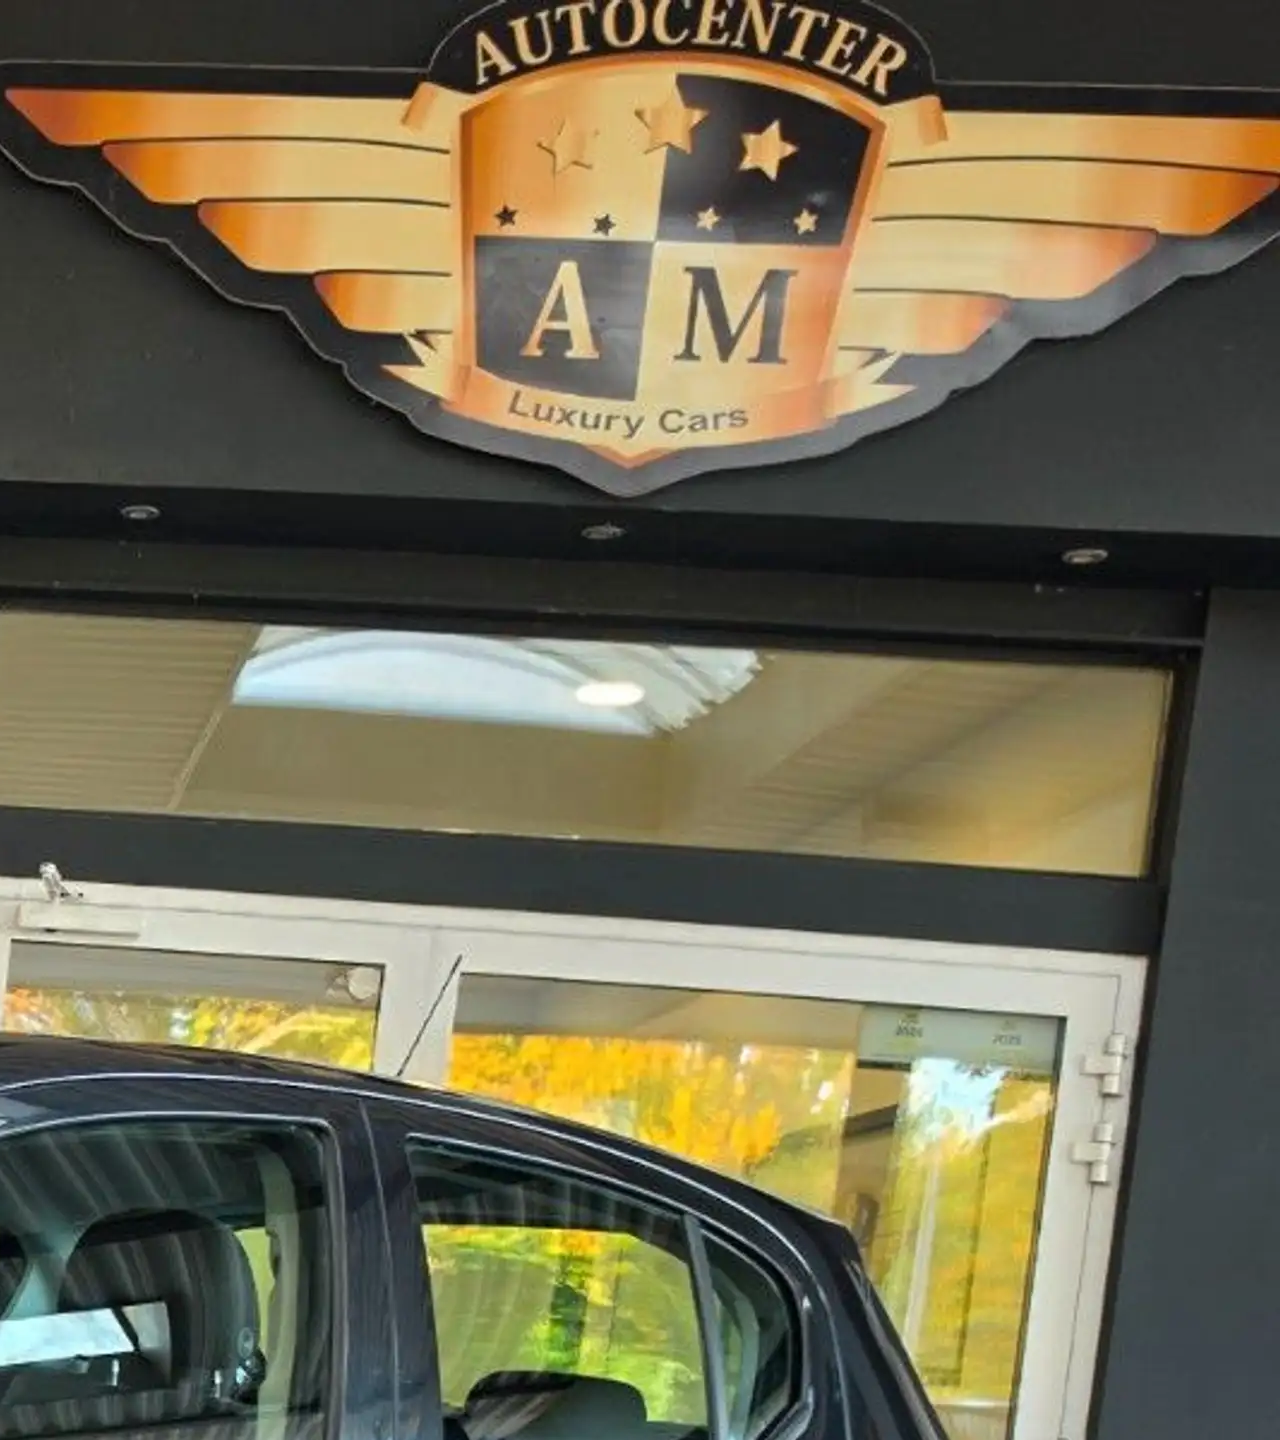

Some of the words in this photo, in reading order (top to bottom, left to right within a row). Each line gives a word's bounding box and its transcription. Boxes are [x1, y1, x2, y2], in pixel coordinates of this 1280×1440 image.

[475, 0, 908, 96] AUTOCENTER
[520, 260, 599, 359] A
[674, 265, 798, 364] M
[508, 390, 644, 438] Luxury
[658, 407, 748, 433] Cars
